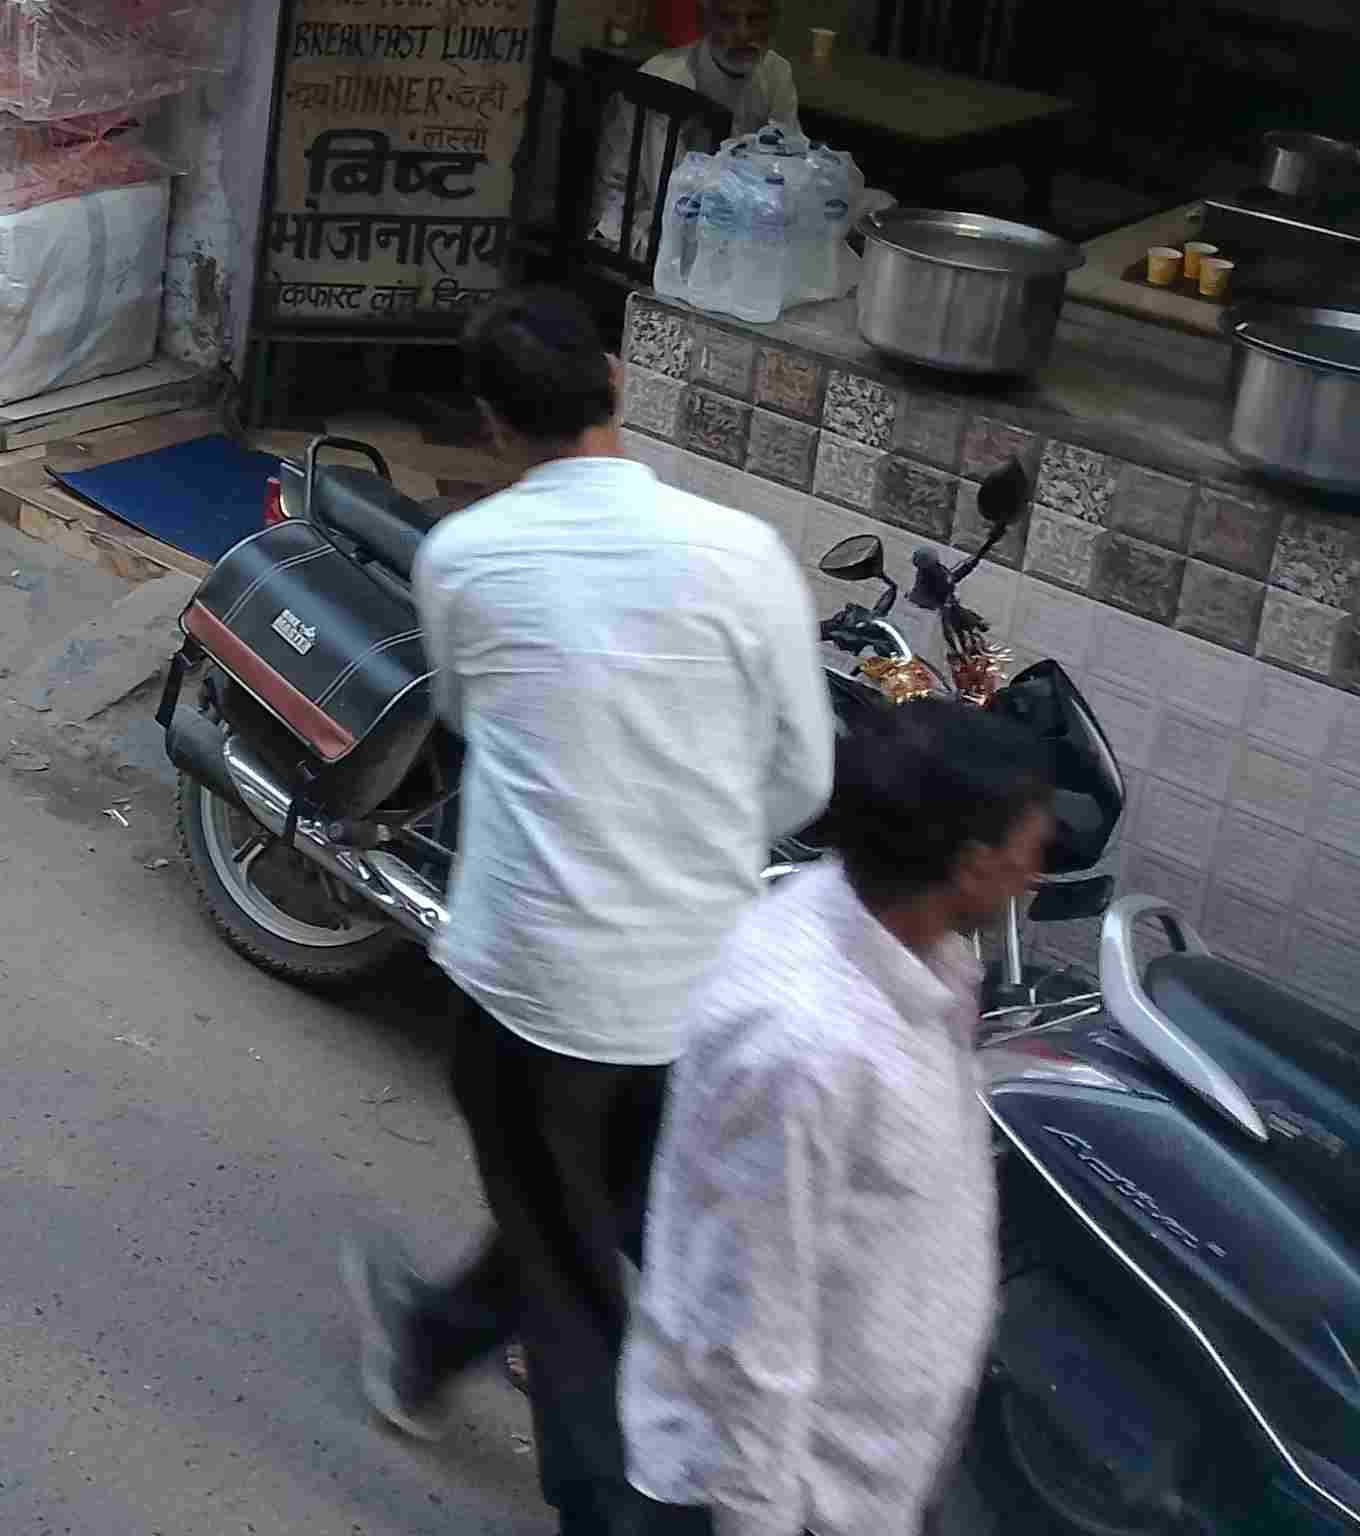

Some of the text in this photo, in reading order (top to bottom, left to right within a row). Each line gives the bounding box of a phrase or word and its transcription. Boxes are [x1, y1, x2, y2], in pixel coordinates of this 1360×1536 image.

[293, 21, 529, 63] BREAKFAST LUNCH
[332, 74, 447, 120] DINNER
[303, 128, 488, 199] बिष्ट
